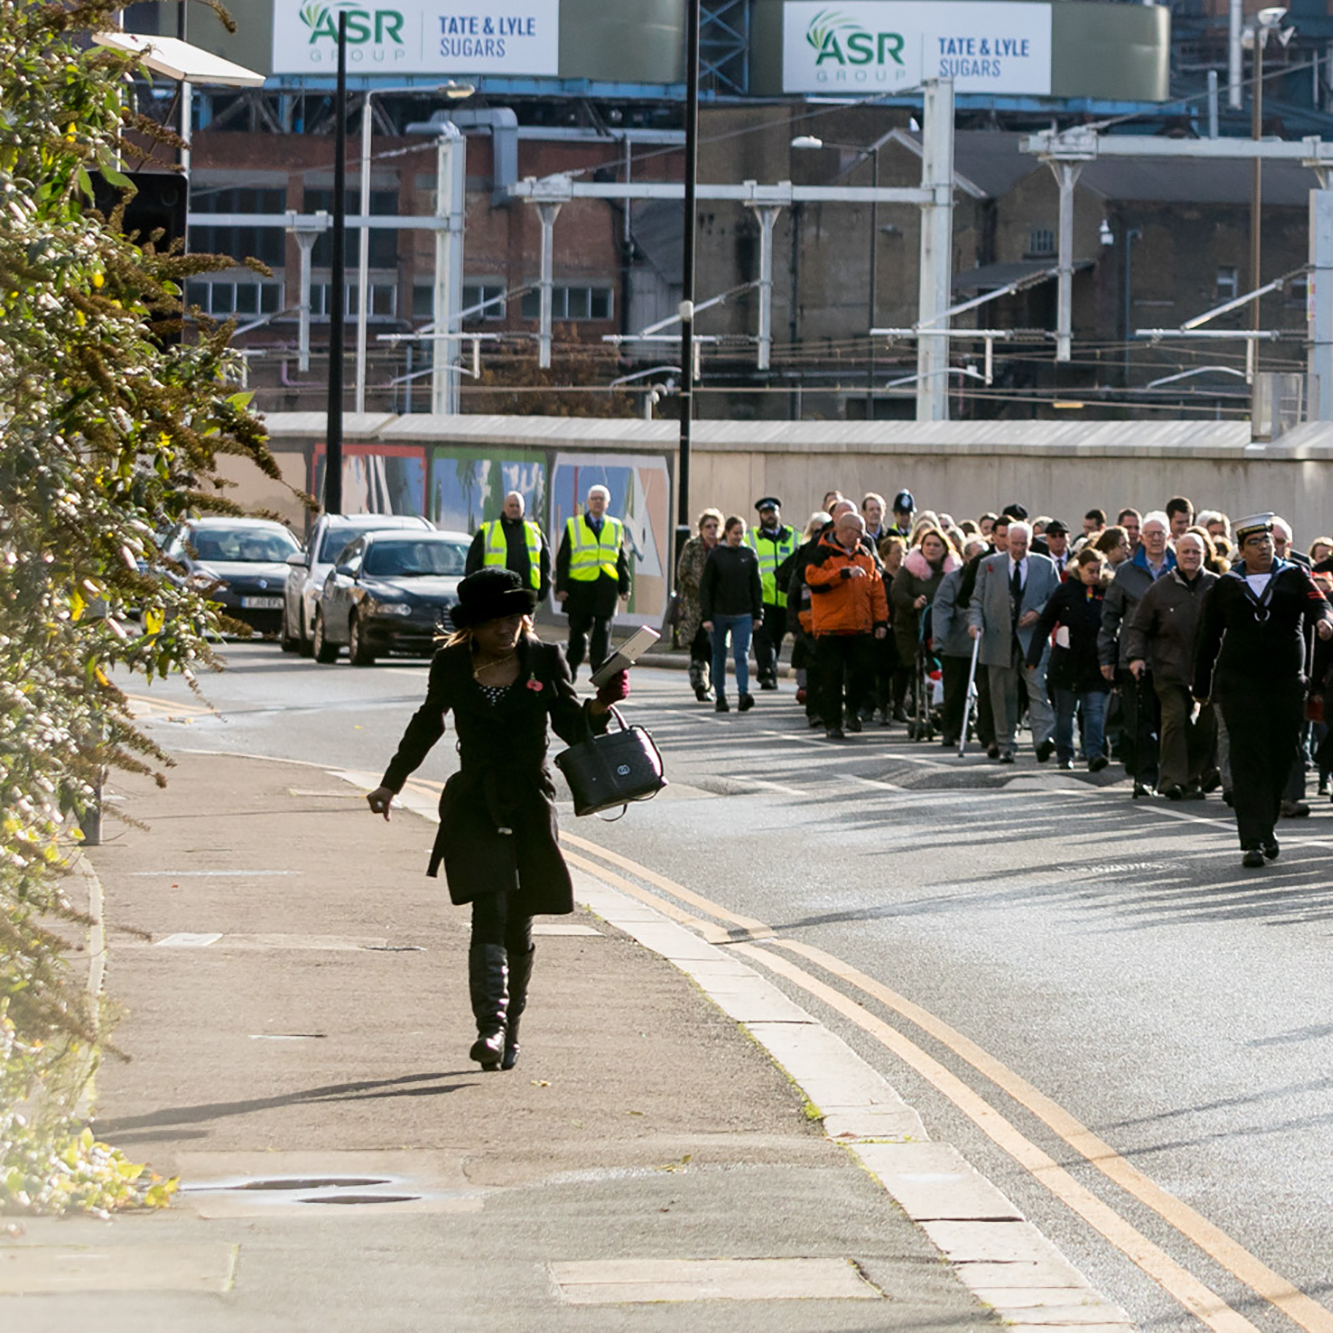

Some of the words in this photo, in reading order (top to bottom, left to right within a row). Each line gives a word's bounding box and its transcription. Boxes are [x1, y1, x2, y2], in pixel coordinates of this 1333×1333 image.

[308, 7, 404, 45] ASR
[439, 16, 479, 35] TATE
[482, 16, 495, 35] &
[499, 17, 536, 36] LYLE
[440, 37, 506, 58] SUGARS
[815, 29, 905, 66] ASR
[938, 37, 976, 56] TATE
[979, 37, 990, 56] &
[994, 38, 1030, 57] LYLE
[816, 68, 906, 83] GROUP
[939, 57, 1001, 78] SUGARS
